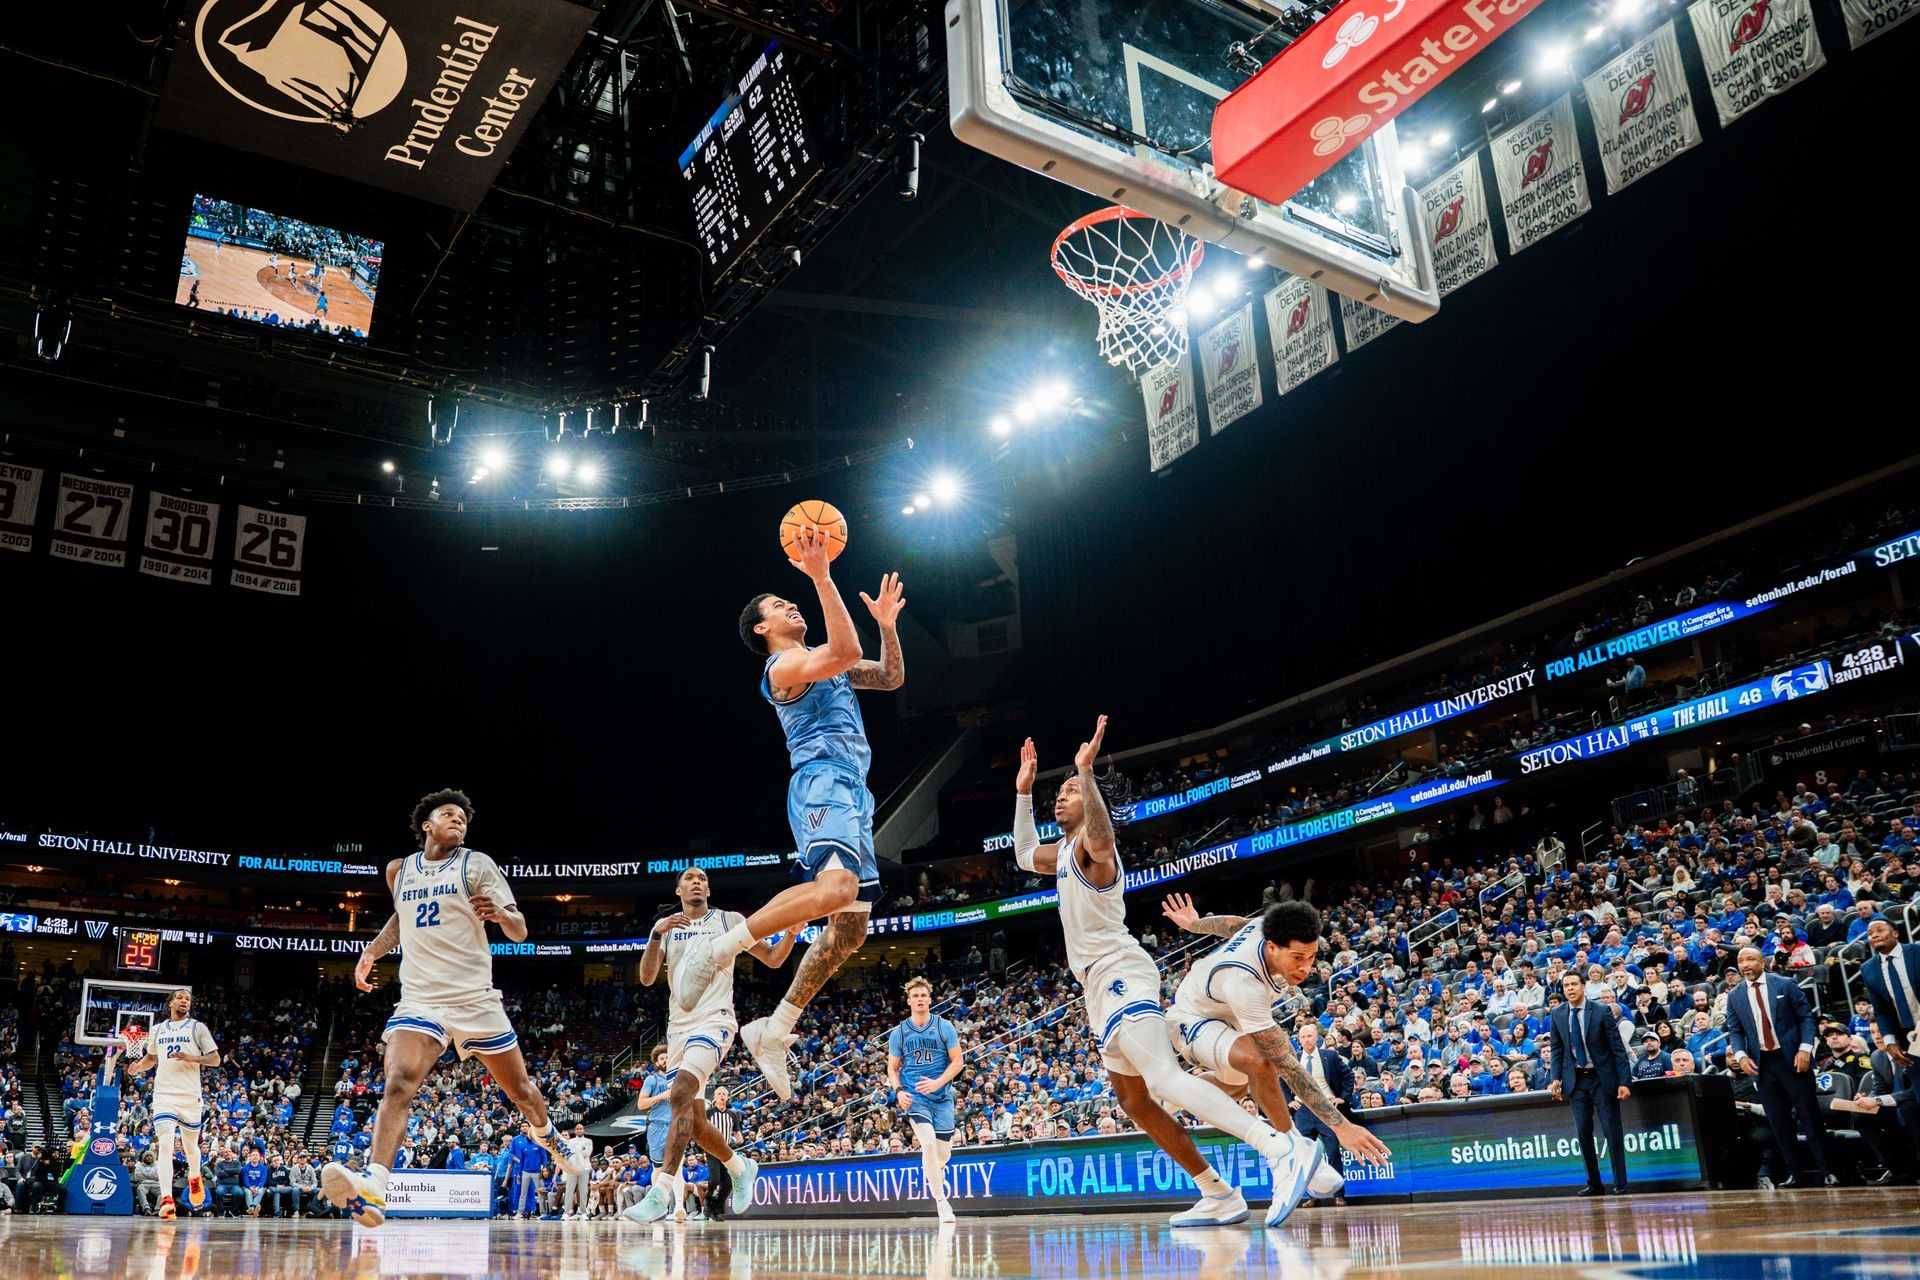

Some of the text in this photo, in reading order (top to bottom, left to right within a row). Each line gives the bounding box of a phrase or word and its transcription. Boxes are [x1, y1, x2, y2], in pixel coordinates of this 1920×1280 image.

[1601, 42, 1654, 83] NEW JERSEY
[1711, 12, 1810, 90] EASTERN CONFERENCE
[1358, 24, 1479, 114] State
[1608, 53, 1654, 93] DEVILS
[1726, 39, 1803, 99] CHAMPIONS
[384, 16, 500, 170] Prudential
[749, 85, 764, 110] 62
[1732, 59, 1806, 113] 2000-2001
[454, 67, 537, 158] Center
[1601, 91, 1688, 158] ATLANTIC DIVISION
[1506, 110, 1554, 146] NEW JERSEY
[1511, 122, 1552, 156] DEVILS
[705, 140, 718, 164] 46
[1620, 120, 1676, 167] CHAMPIONS
[1620, 134, 1685, 184] 2000-2001
[1421, 167, 1464, 203] NEW JERSEY
[1426, 180, 1462, 213] DEVILS
[1505, 161, 1580, 219] EASTERN CONFERENCE
[1517, 183, 1575, 231] CHAMPIONS
[1519, 202, 1576, 245] 1999-2000
[1431, 218, 1487, 266] ANTIC DIVISION
[1434, 243, 1479, 280] CHAMPIONS
[1438, 256, 1485, 293] 998-1999
[1279, 281, 1309, 309] DEVILS
[1212, 326, 1239, 351] DEVILS
[1286, 339, 1322, 371] CHAMPIONS
[1287, 352, 1327, 387] 1996-1997
[1154, 366, 1178, 391] DEVILS
[0, 464, 32, 482] EYKO
[62, 476, 130, 499] NIEDERMAYER
[63, 491, 124, 537] 27
[160, 496, 208, 516] BRODEUR
[257, 512, 287, 528] ELIAS
[1, 533, 30, 547] 2003
[151, 509, 211, 556] 30
[241, 522, 297, 568] 26
[55, 542, 121, 563] 1991 2004
[1874, 533, 1920, 570] SET
[143, 559, 208, 581] 1990 2014
[234, 573, 296, 593] 1994 2016
[1745, 559, 1856, 609] setonhall.edu/forall
[1681, 610, 1734, 634] Greater Seton Hall
[1687, 609, 1715, 626] Campaign
[1716, 606, 1724, 617] for
[1545, 620, 1679, 680] FOR ALL FOREVER
[1841, 644, 1884, 669] 4:28
[1834, 655, 1897, 684] 2ND HALF
[1340, 668, 1534, 752] SETON HALL UNIVERSITY
[1738, 687, 1762, 706] 46
[1672, 696, 1728, 728] THE HALL
[1652, 727, 1659, 735] 2
[1267, 744, 1330, 773] setonhall.edu/forall
[1519, 738, 1582, 774] SETON
[1785, 734, 1866, 762] Prudential Center
[1410, 769, 1492, 804] setonhall.edu/forall
[1816, 770, 1827, 785] 8
[1145, 796, 1165, 816] FOR
[1166, 790, 1185, 809] ALL
[1185, 776, 1229, 803] FOREVER
[1359, 804, 1379, 816] Campaign
[1250, 808, 1354, 853] FOR ALL FOREVER
[38, 833, 231, 866] SETON HALL UNIVERSITY
[238, 854, 261, 868] FOR
[263, 856, 286, 870] ALL
[288, 858, 341, 873] FOREVER
[647, 859, 668, 872] FOR
[693, 854, 744, 869] FOREVER
[1409, 849, 1416, 861] 9
[512, 864, 550, 876] HALL
[554, 862, 640, 876] UNIVERSITY
[1124, 843, 1237, 890] HALL UNIVERSITY
[401, 882, 457, 901] SETON HALL
[43, 918, 68, 928] 4:28
[416, 901, 440, 928] 22
[37, 925, 74, 935] 2ND HALF
[131, 934, 158, 945] 4:28
[235, 935, 326, 951] SETON HALL
[125, 944, 152, 966] 25
[488, 943, 535, 955] OREVER
[906, 1038, 938, 1052] VILLANOVA
[914, 1049, 932, 1065] 24
[1026, 1153, 1132, 1197] FOR ALL
[1369, 1162, 1394, 1179] Hall
[385, 1193, 411, 1203] Bank
[386, 1182, 436, 1192] Columbia
[786, 1172, 841, 1204] HALL
